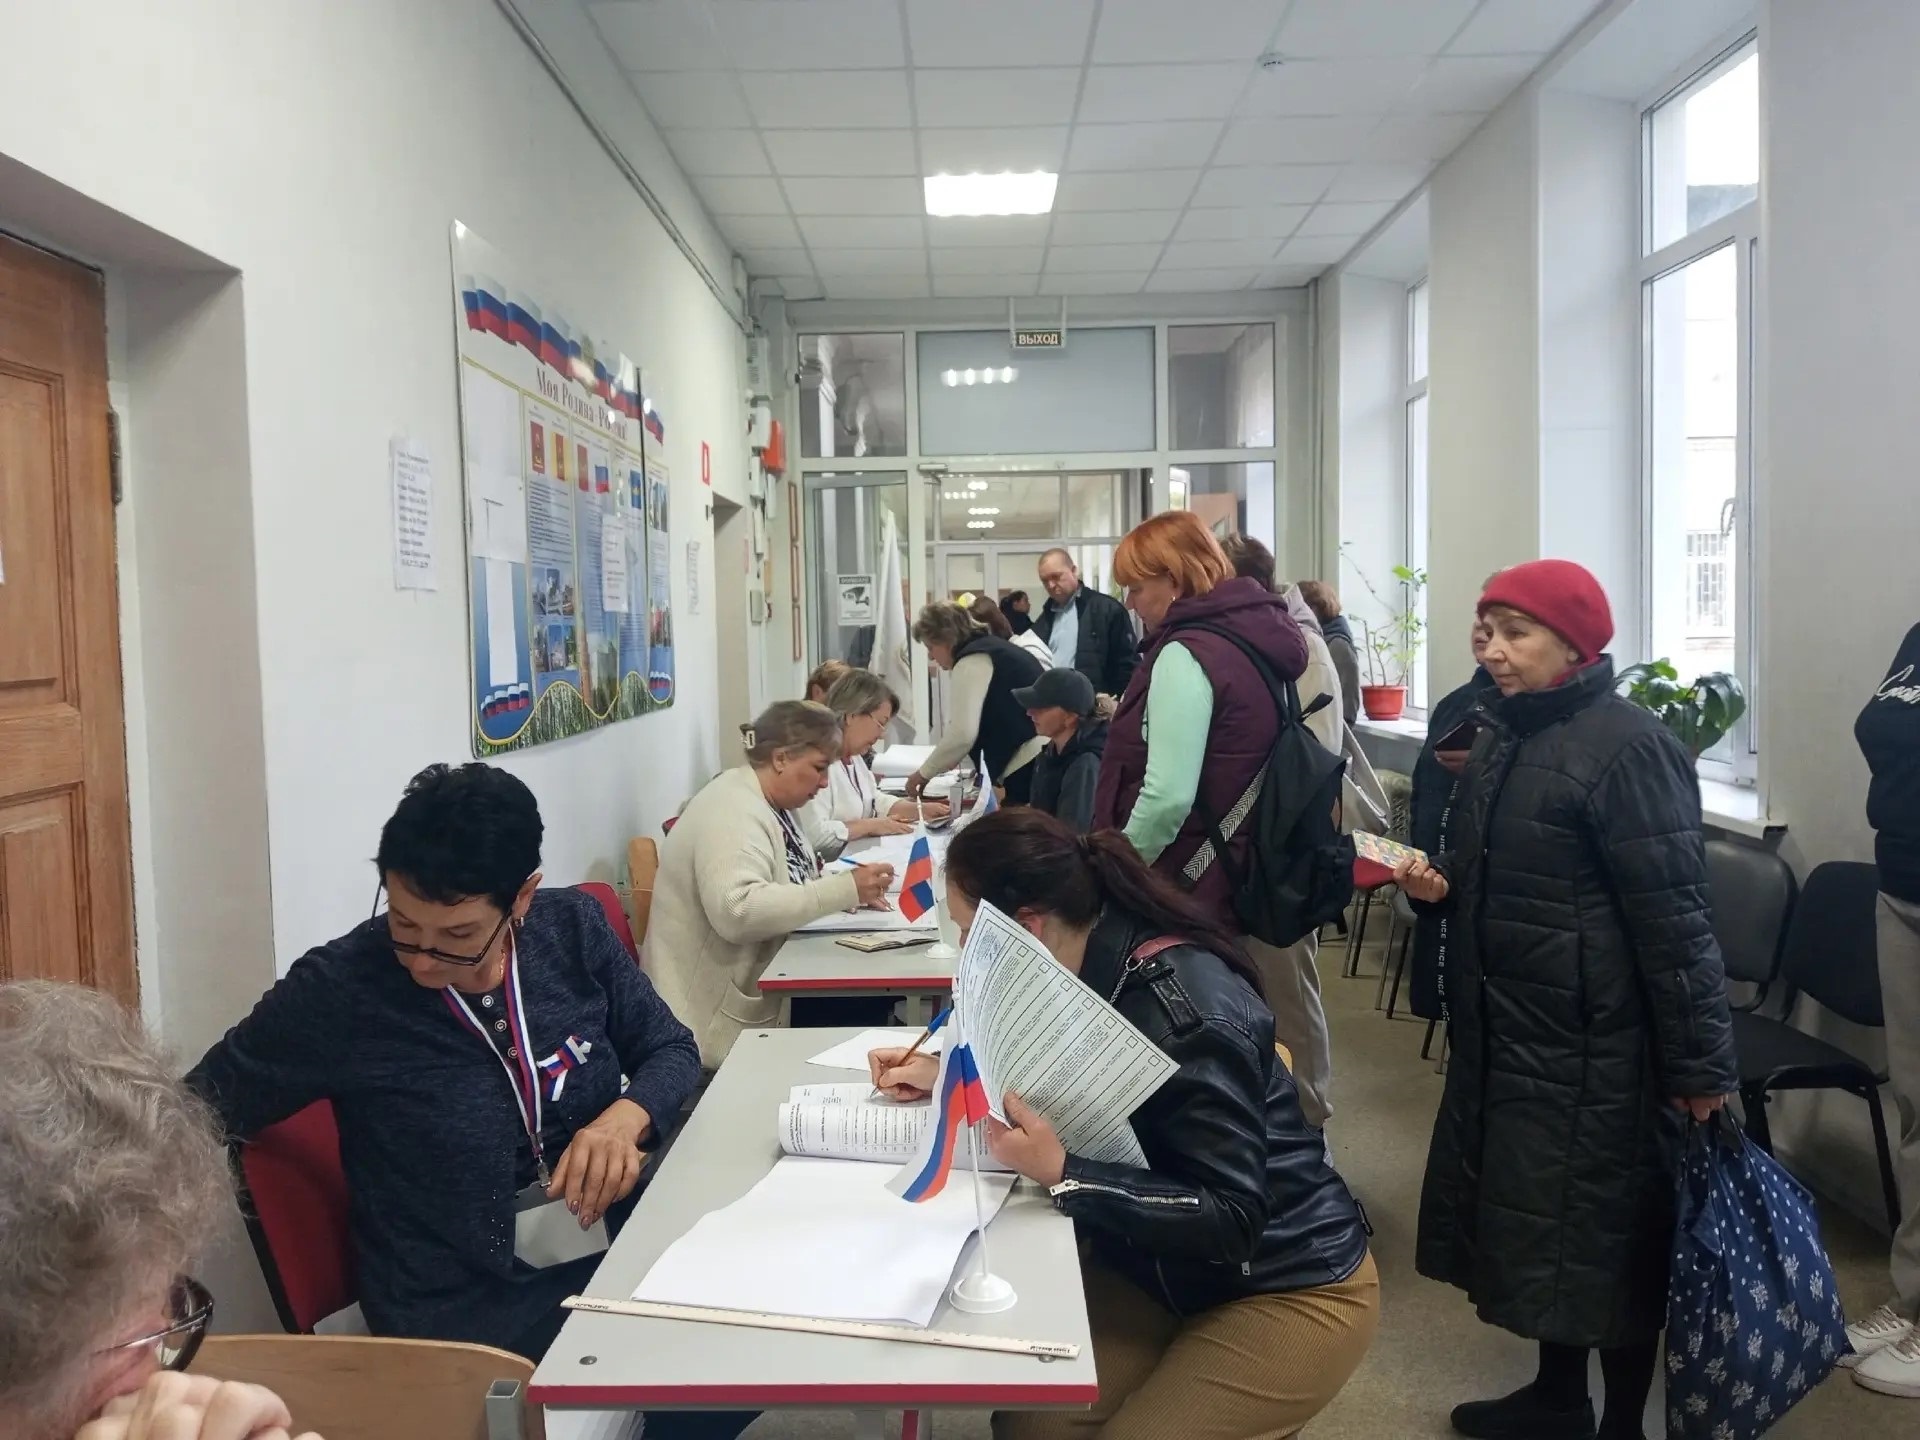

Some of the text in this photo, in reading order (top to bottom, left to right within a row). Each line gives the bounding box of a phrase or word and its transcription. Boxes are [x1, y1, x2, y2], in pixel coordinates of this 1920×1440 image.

[1018, 333, 1059, 345] ВЫХОД
[536, 367, 559, 404] Моя
[1441, 807, 1451, 828] NICE
[1438, 945, 1446, 968] NICE
[1437, 974, 1445, 996] NICE
